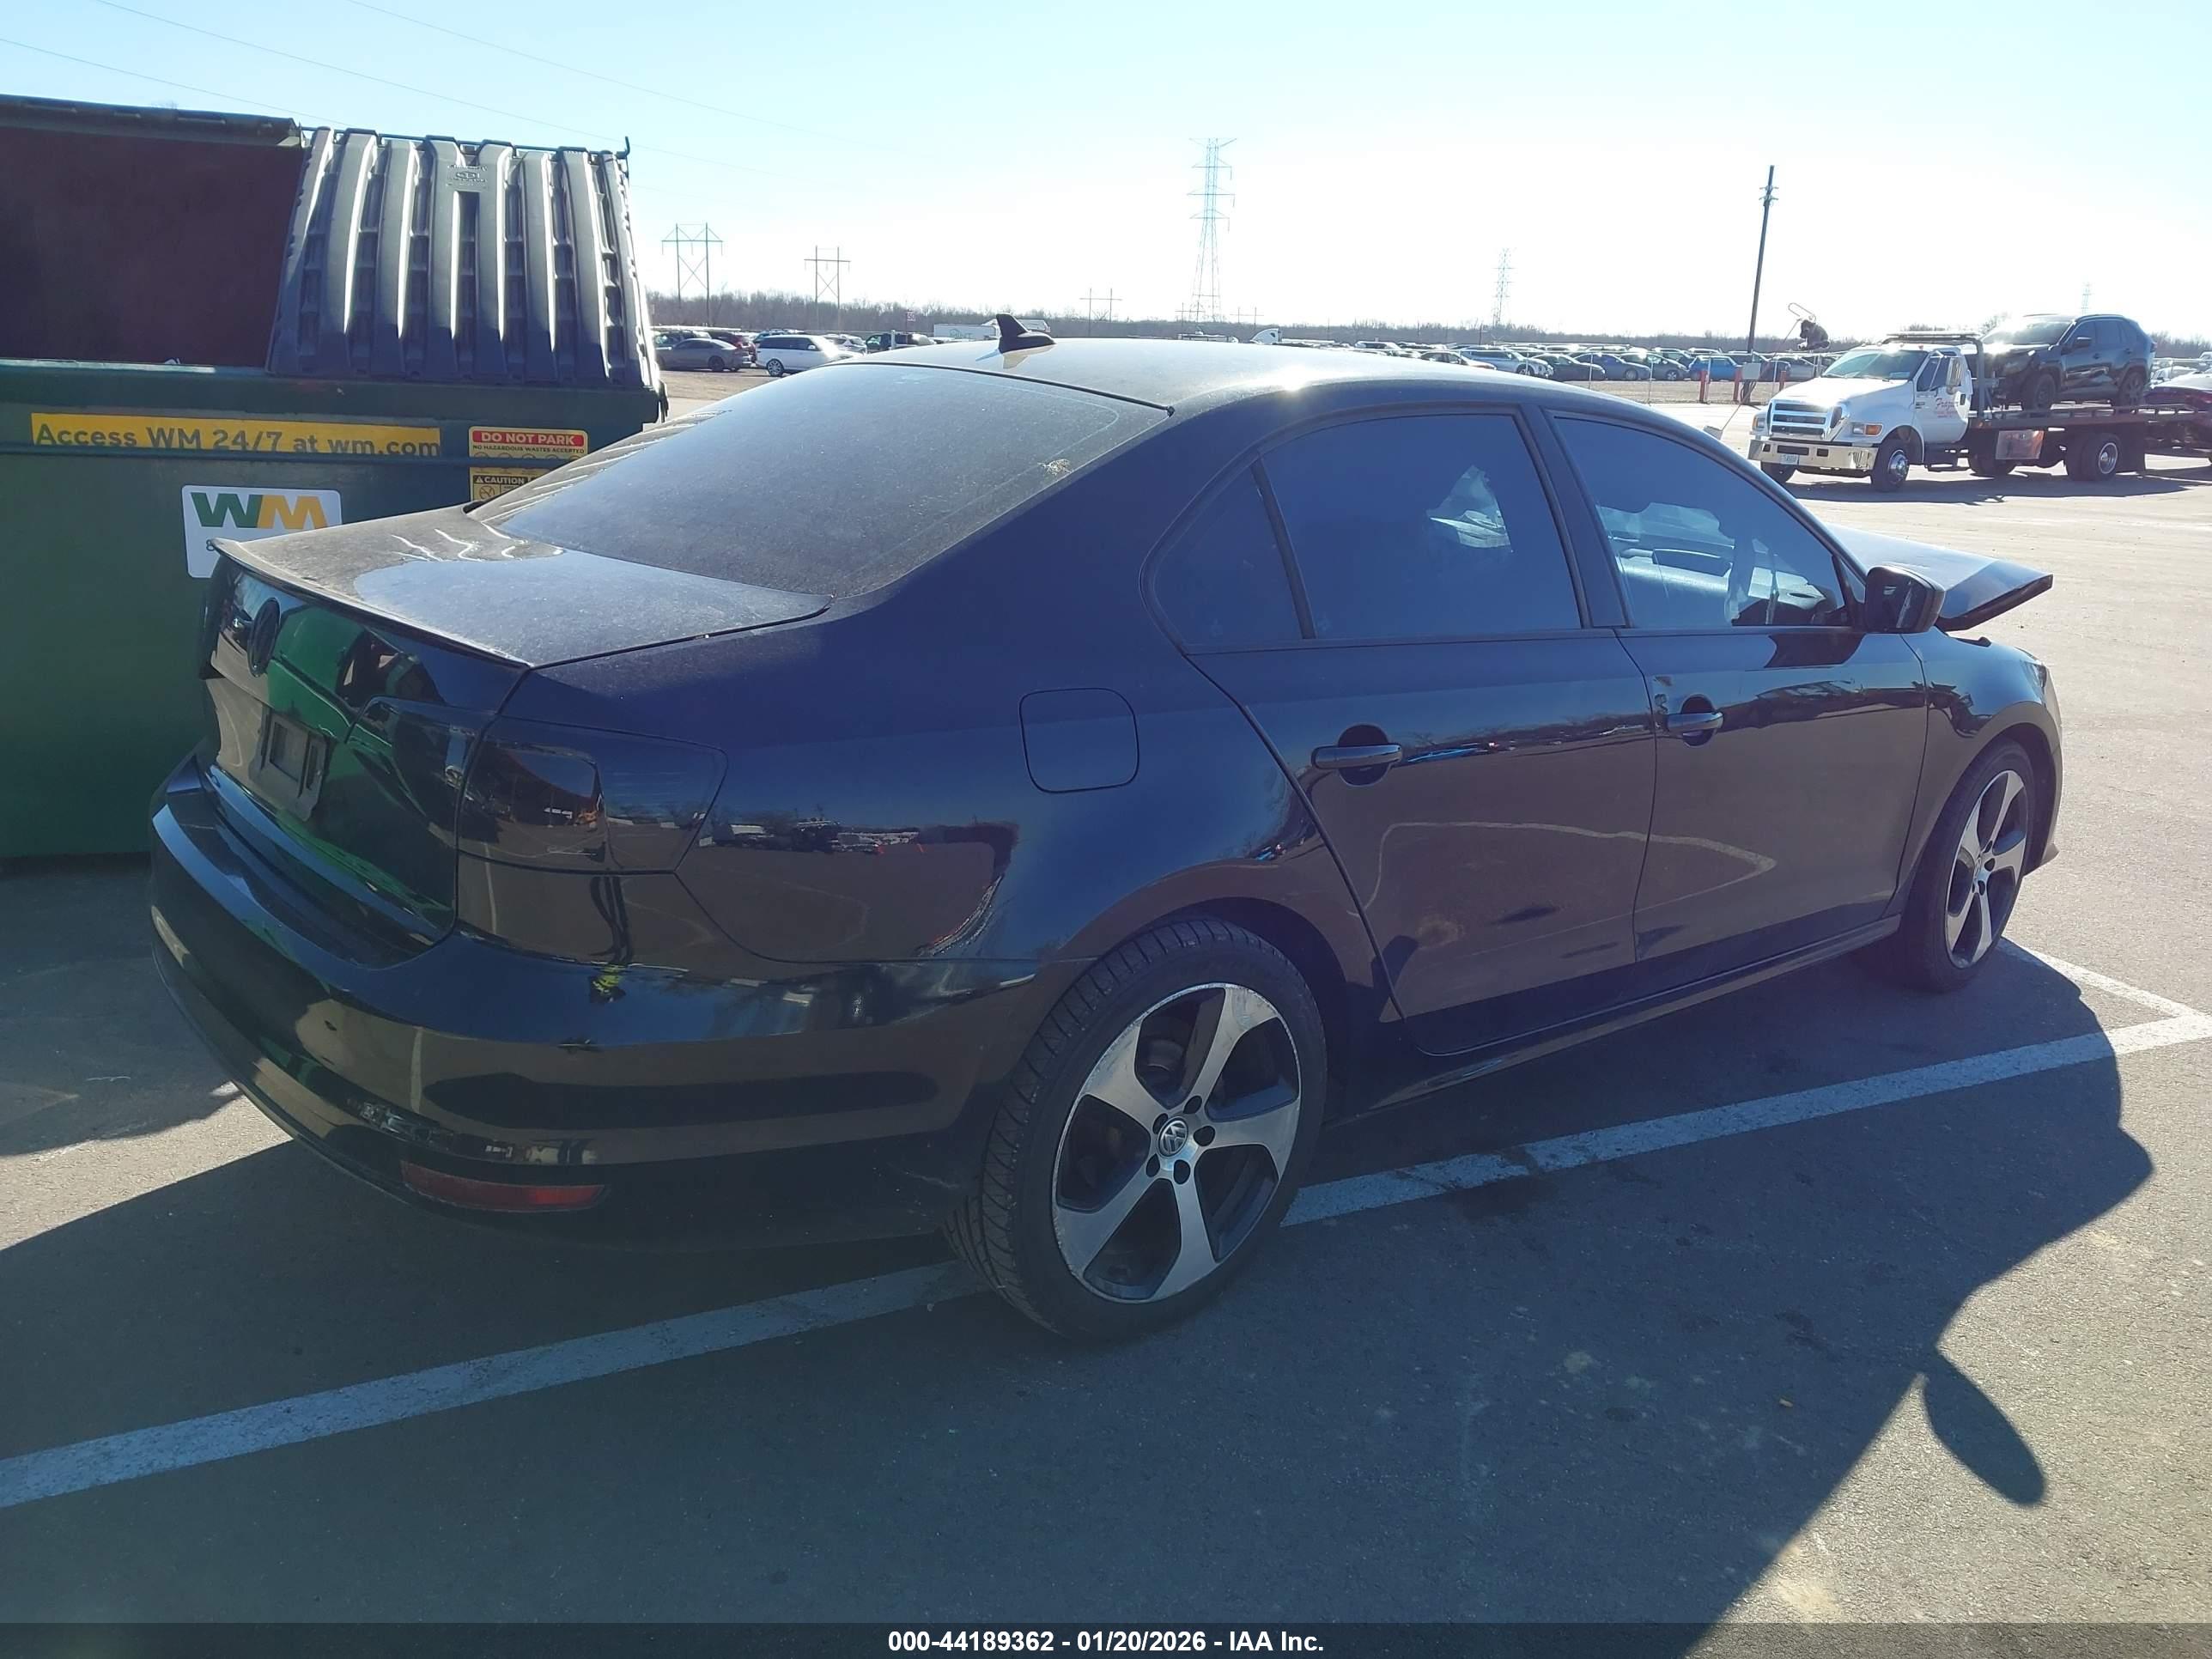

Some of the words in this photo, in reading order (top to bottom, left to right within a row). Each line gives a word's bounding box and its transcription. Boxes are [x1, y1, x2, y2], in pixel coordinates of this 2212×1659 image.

[35, 423, 137, 447] Access
[146, 427, 202, 449] WM
[212, 429, 283, 453] 24/7
[293, 434, 318, 453] at
[327, 439, 441, 457] wm.com
[481, 432, 502, 442] DO
[506, 433, 535, 444] NOT
[538, 434, 575, 445] PARK
[191, 492, 329, 530] WM
